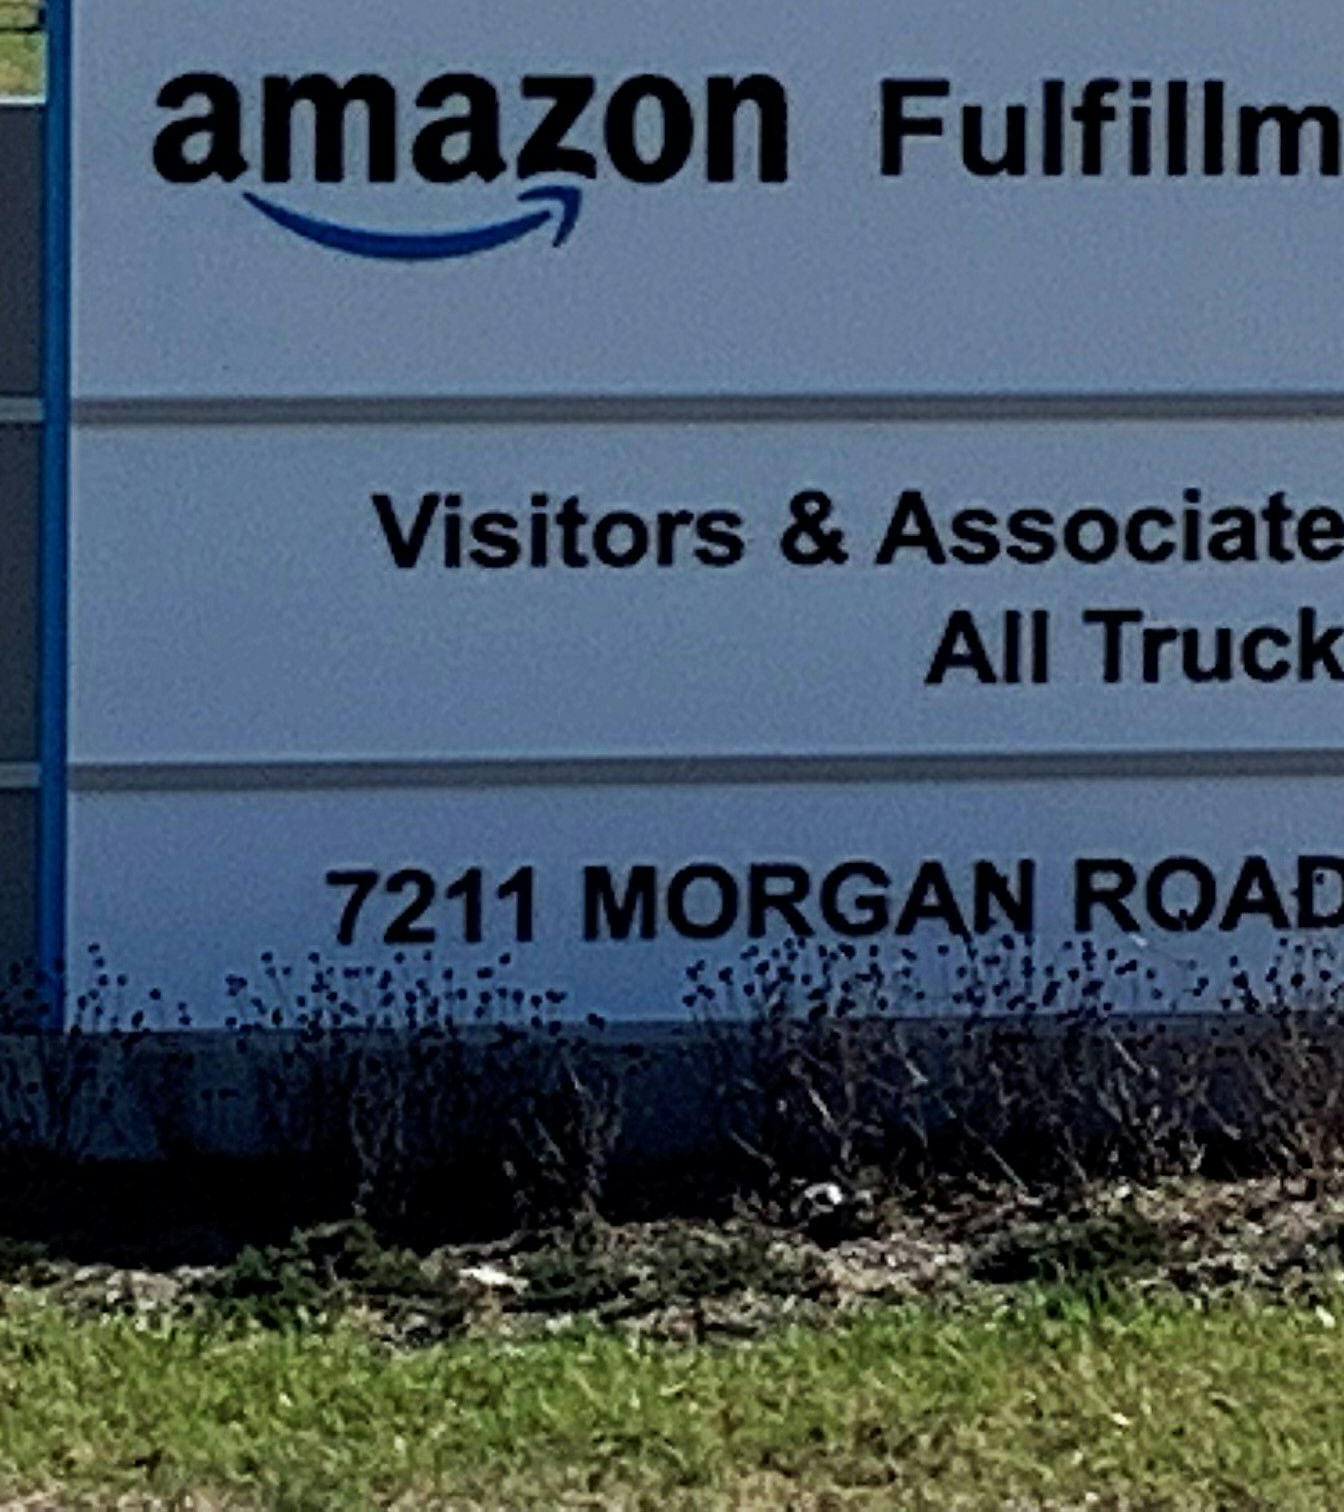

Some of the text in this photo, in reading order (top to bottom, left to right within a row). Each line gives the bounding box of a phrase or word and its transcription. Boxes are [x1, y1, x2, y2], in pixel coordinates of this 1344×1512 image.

[152, 72, 788, 185] amazon
[371, 492, 745, 570] Visitors
[780, 490, 850, 567] &
[924, 610, 1050, 686] All
[325, 866, 535, 946] 7211
[580, 858, 1037, 941] MORGAN
